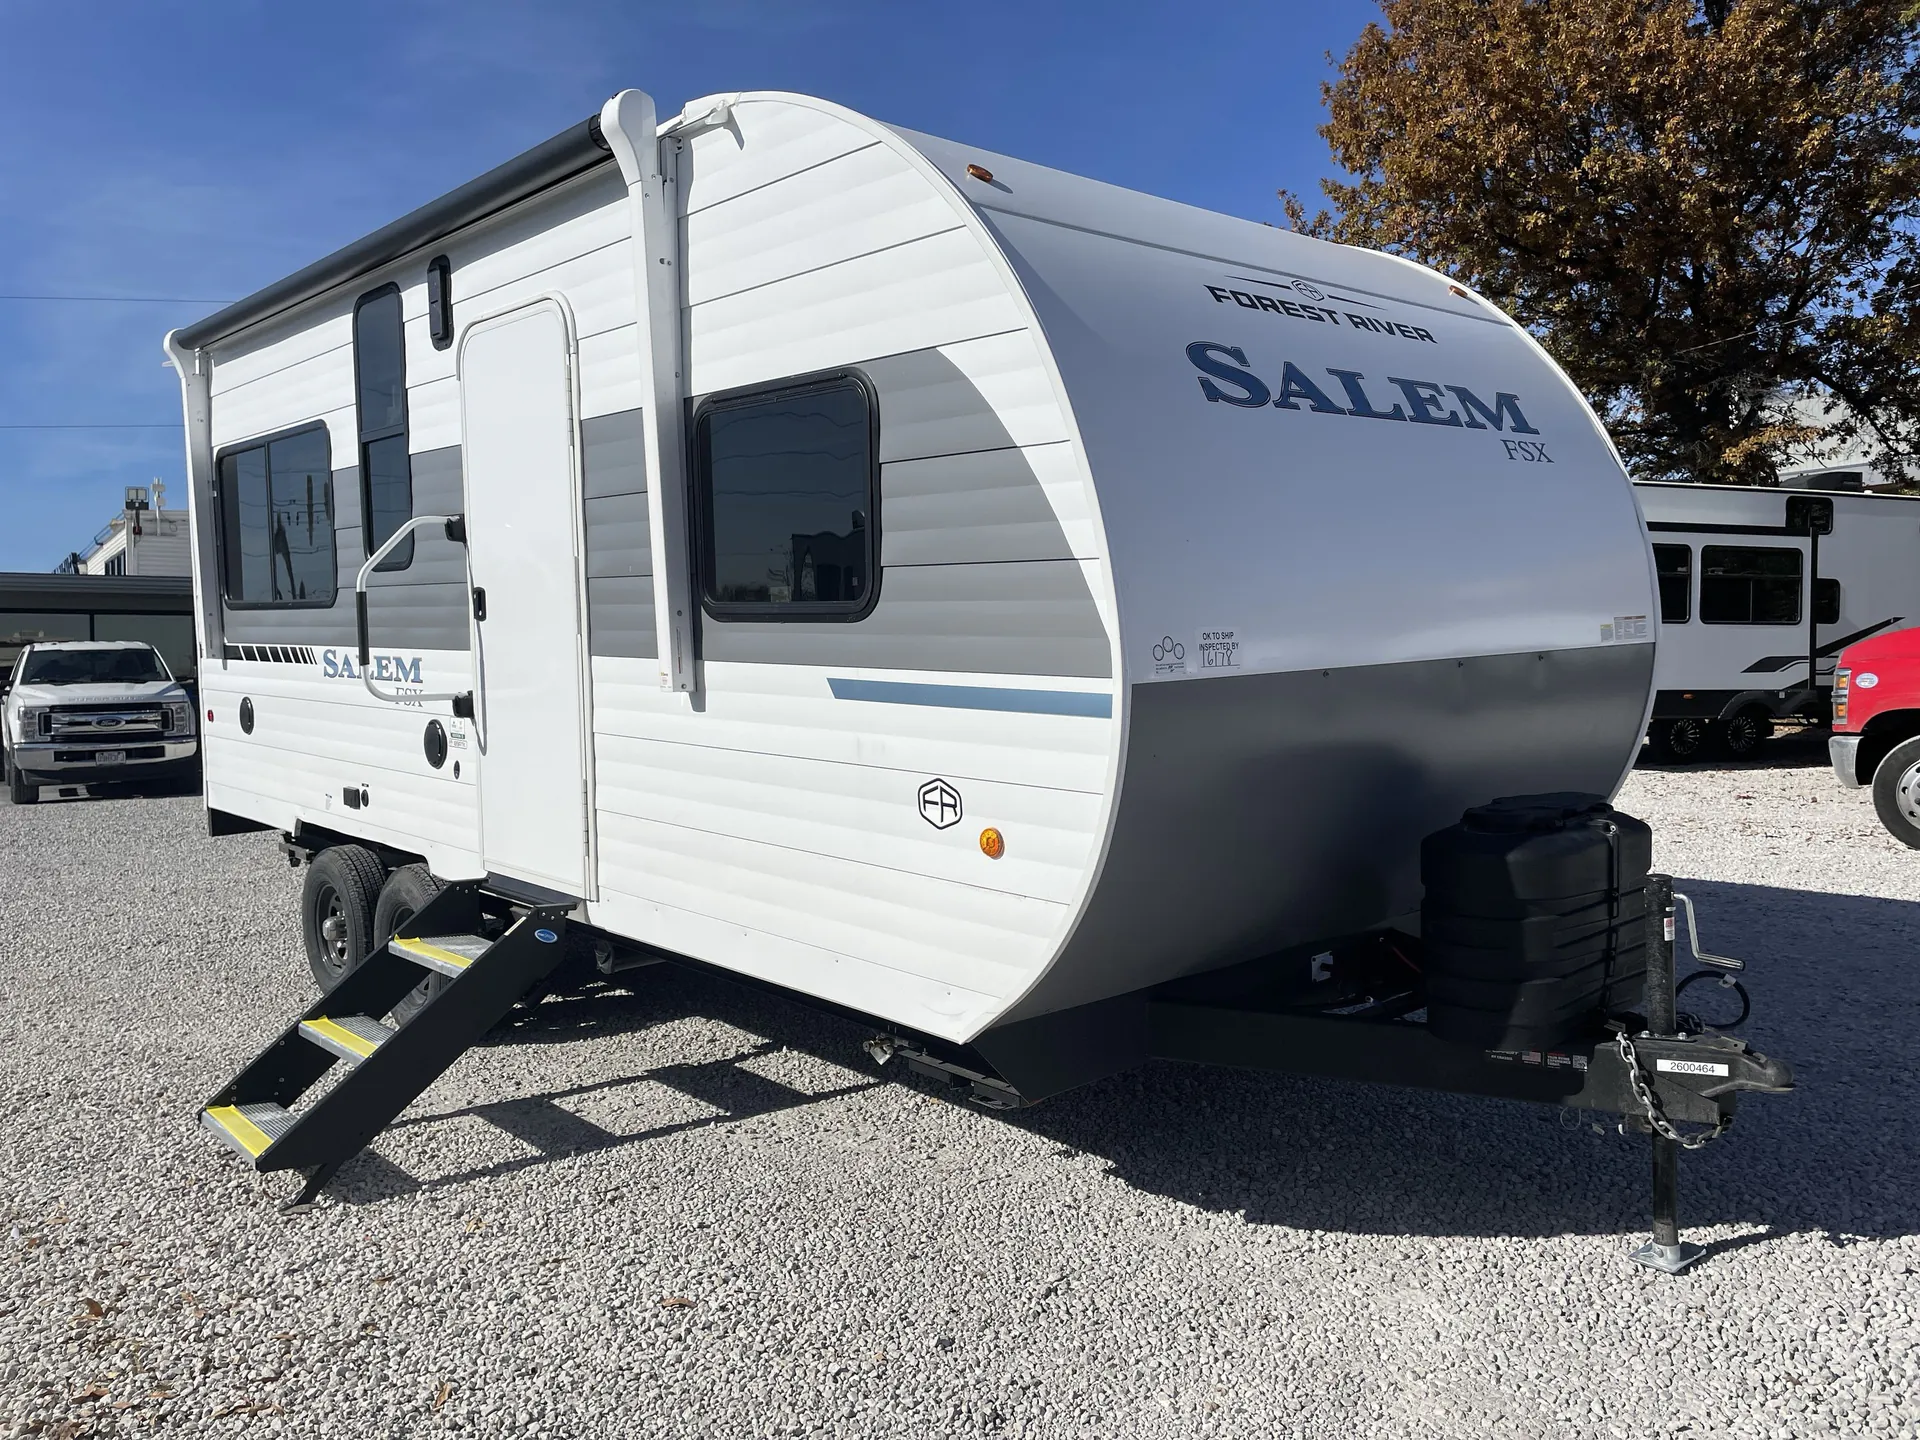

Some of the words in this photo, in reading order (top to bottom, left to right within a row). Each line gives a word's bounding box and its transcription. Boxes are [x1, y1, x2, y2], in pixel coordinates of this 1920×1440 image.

[1203, 284, 1341, 325] FOREST
[1343, 312, 1438, 344] RIVER
[1185, 341, 1541, 435] SALEM
[1501, 439, 1554, 463] FSX
[1202, 632, 1211, 641] OK
[1212, 632, 1220, 640] TO
[1221, 631, 1234, 640] SHIP
[1199, 642, 1231, 651] INSPECTED
[1231, 641, 1240, 650] BY
[1670, 1060, 1716, 1075] 2600464
